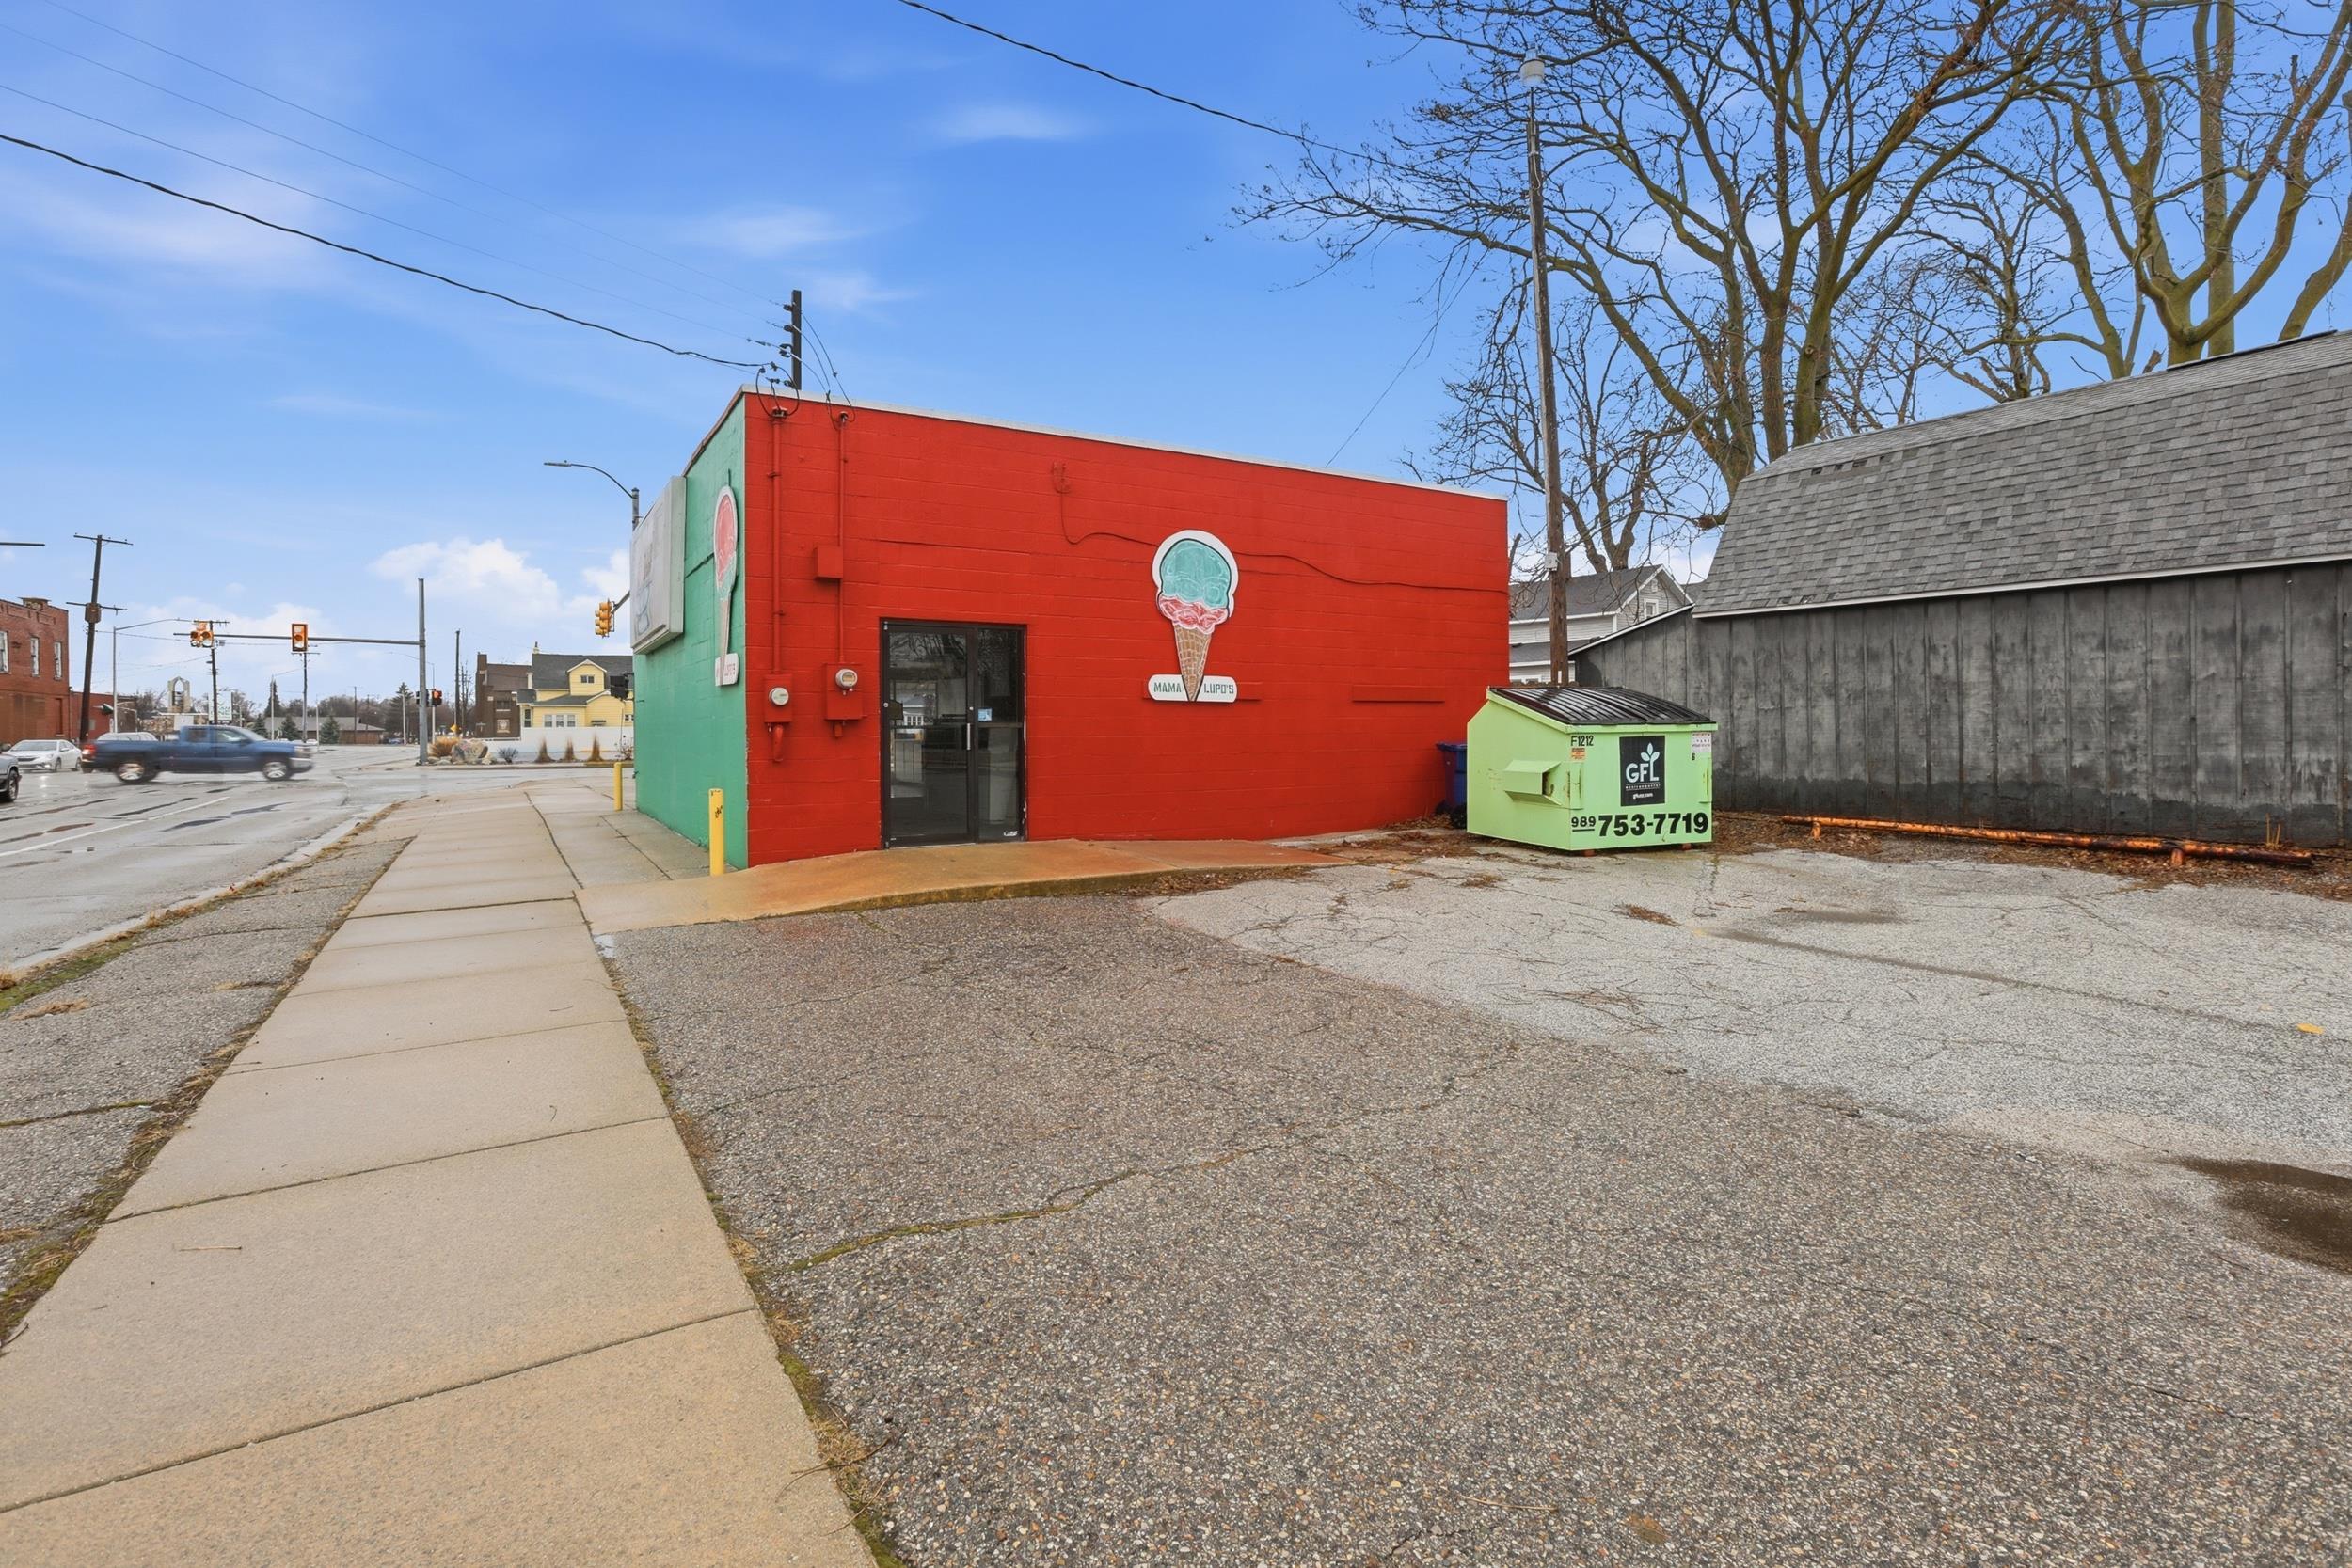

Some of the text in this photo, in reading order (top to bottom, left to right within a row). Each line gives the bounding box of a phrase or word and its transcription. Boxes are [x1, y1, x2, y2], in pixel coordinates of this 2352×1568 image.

[1153, 682, 1234, 694] MAMA LUPO'S
[1570, 736, 1594, 747] F1212
[1626, 753, 1660, 783] GFL
[1571, 812, 1708, 837] 989 753-7719
